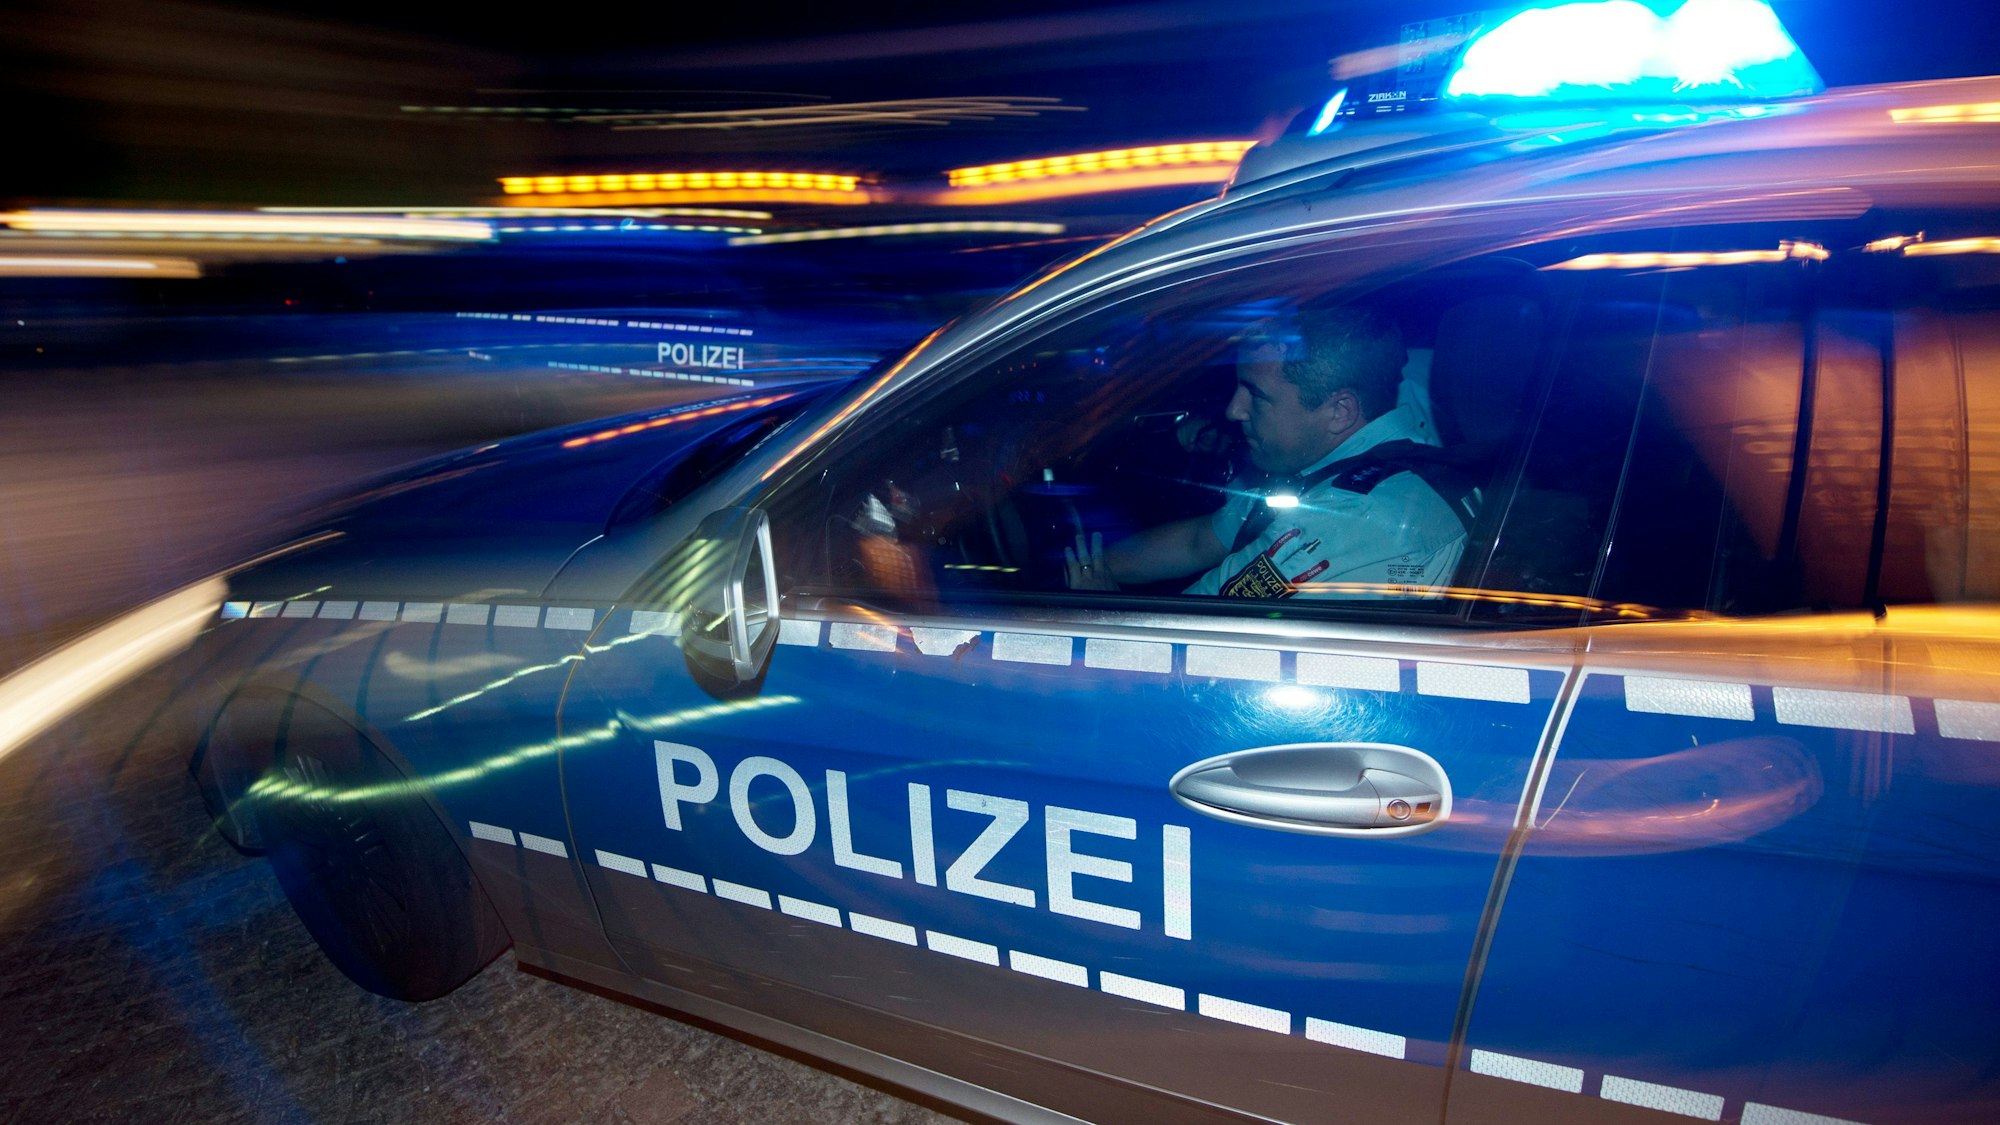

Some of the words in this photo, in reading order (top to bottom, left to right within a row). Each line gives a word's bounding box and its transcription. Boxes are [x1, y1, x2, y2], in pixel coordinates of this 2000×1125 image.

[657, 341, 744, 370] POLIZEI
[1257, 560, 1284, 594] POLIZEI
[653, 740, 1191, 940] POLIZEI
